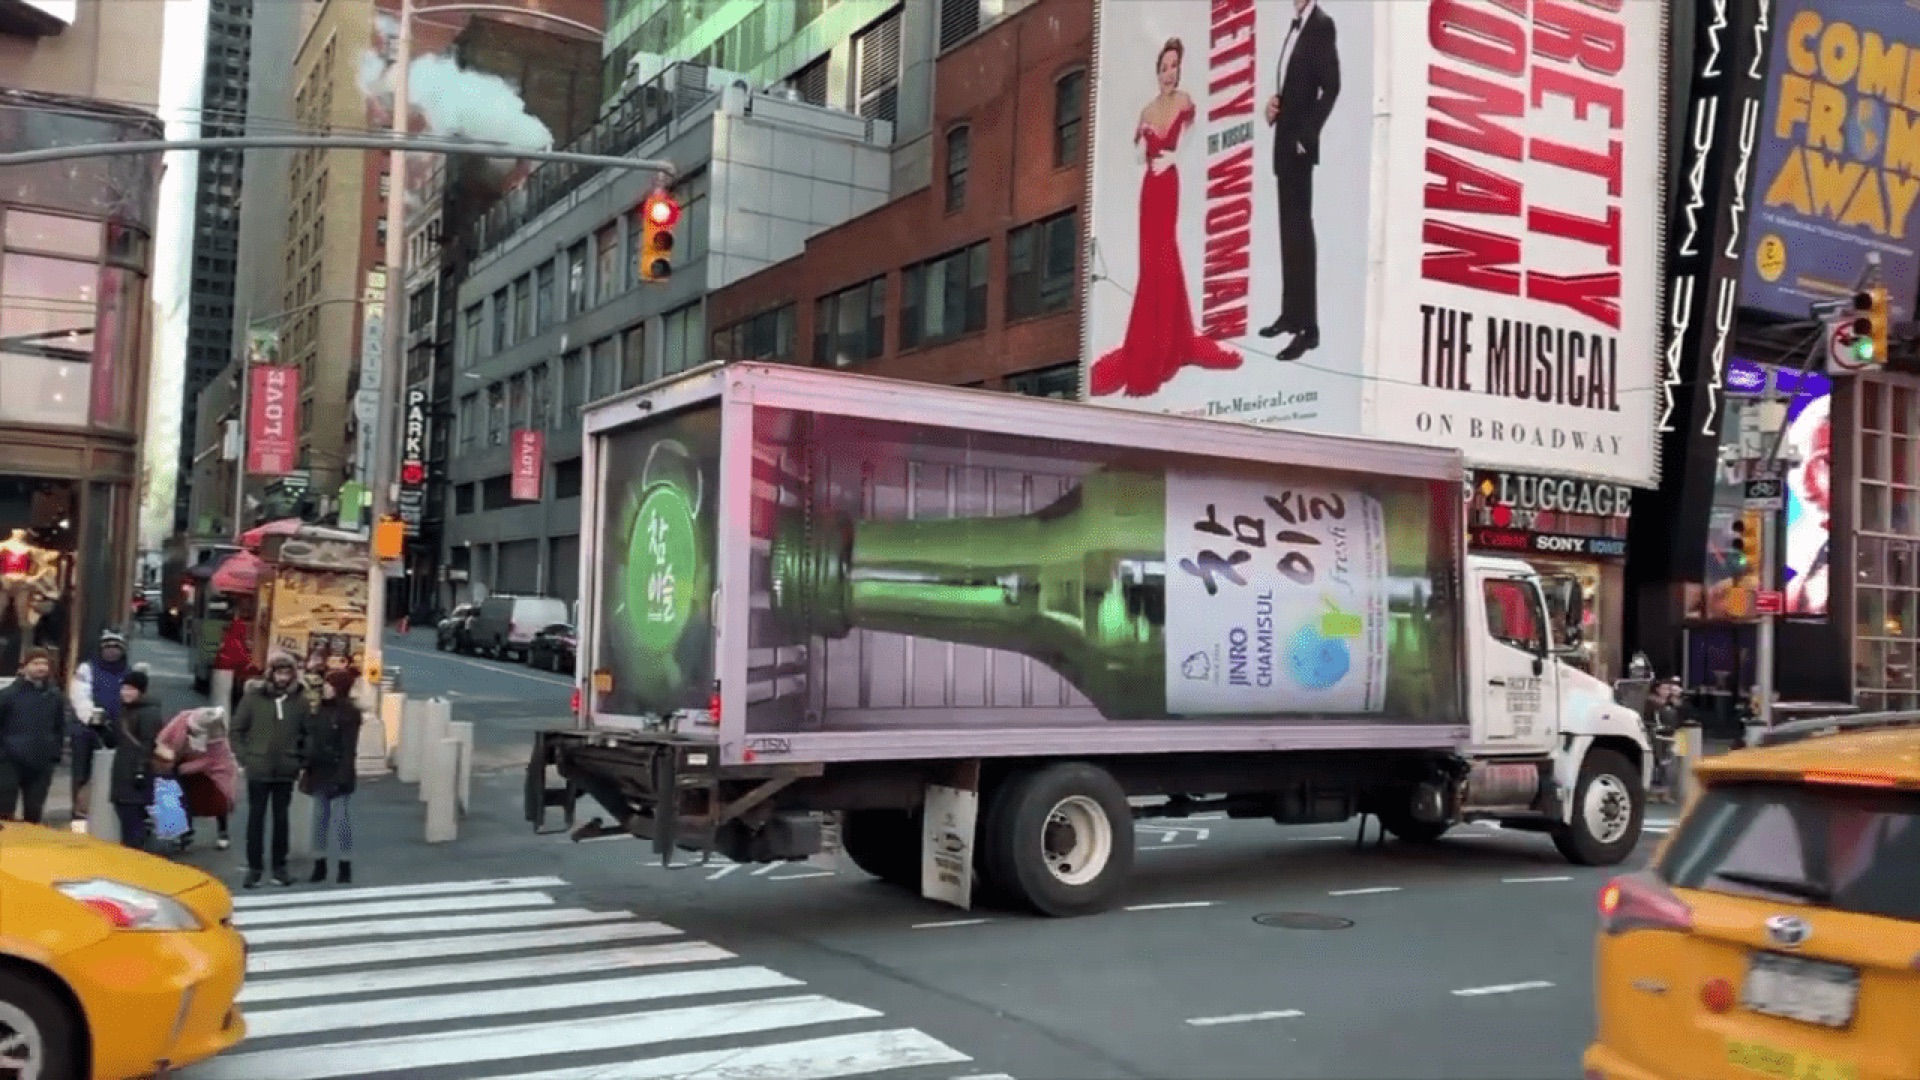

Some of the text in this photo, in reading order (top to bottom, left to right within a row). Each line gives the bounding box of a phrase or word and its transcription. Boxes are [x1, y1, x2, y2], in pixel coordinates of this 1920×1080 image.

[1209, 0, 1255, 122] RETTY
[1421, 0, 1528, 297] OMAN
[1526, 0, 1624, 331] RETTY
[1763, 147, 1920, 239] AWAY
[1203, 146, 1253, 341] WOMAN
[1420, 304, 1620, 412] THE MUSICAL
[263, 370, 285, 436] LOVE
[407, 391, 424, 453] PARK
[1416, 412, 1622, 455] ON BROADWAY
[521, 432, 535, 475] LOVE
[1499, 473, 1632, 518] LUGGAGE
[1536, 536, 1584, 552] SONY
[1229, 627, 1251, 686] JINRO
[1256, 589, 1273, 687] CHAMISUL
